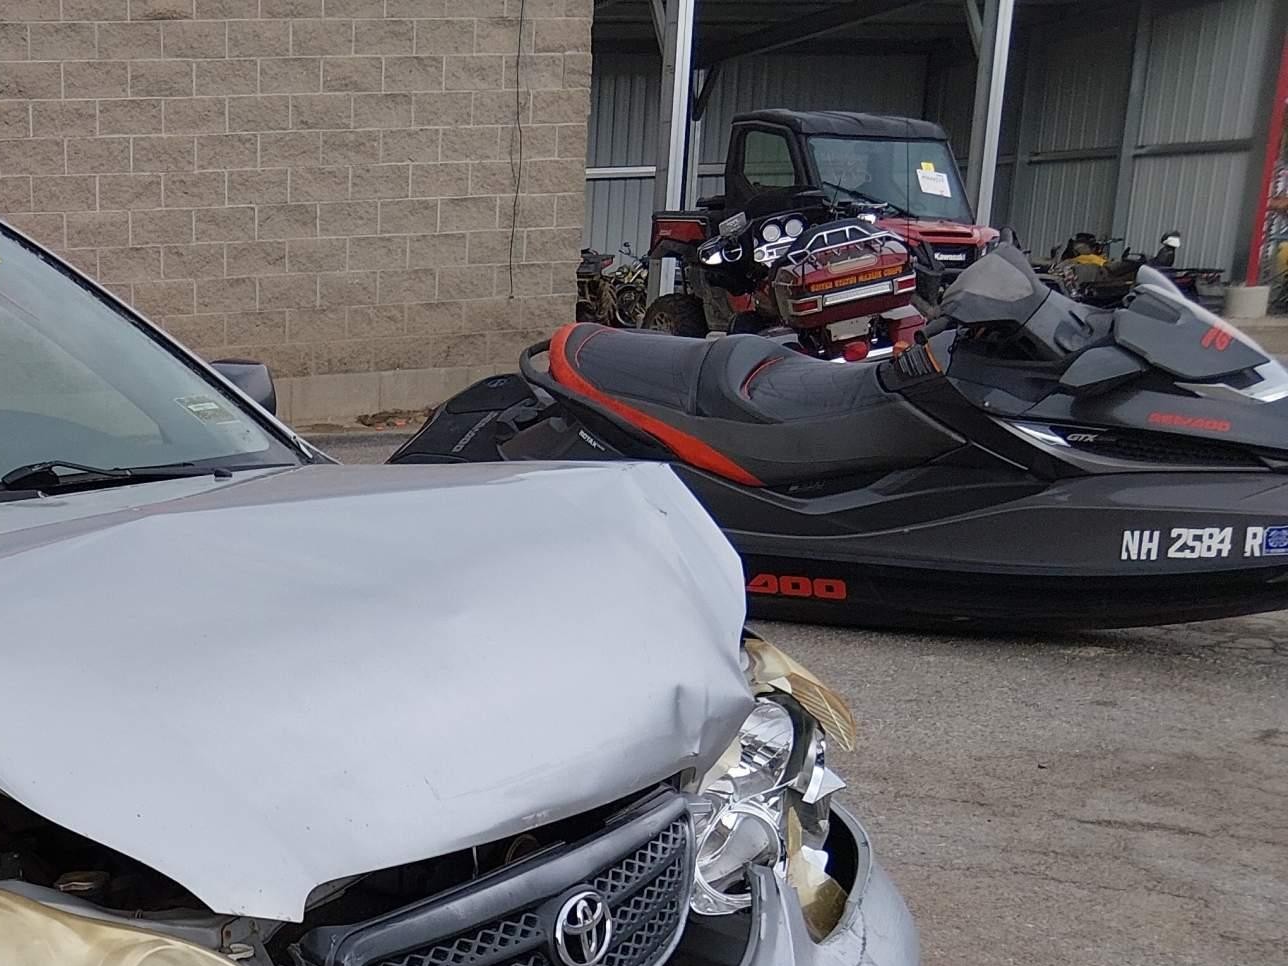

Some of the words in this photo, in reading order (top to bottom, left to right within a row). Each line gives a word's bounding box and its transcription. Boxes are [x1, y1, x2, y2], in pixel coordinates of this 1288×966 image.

[934, 252, 967, 261] Kawasaki
[1066, 433, 1099, 443] GTX
[1121, 530, 1161, 560] NH
[1167, 527, 1234, 559] 2584
[1243, 526, 1264, 557] R
